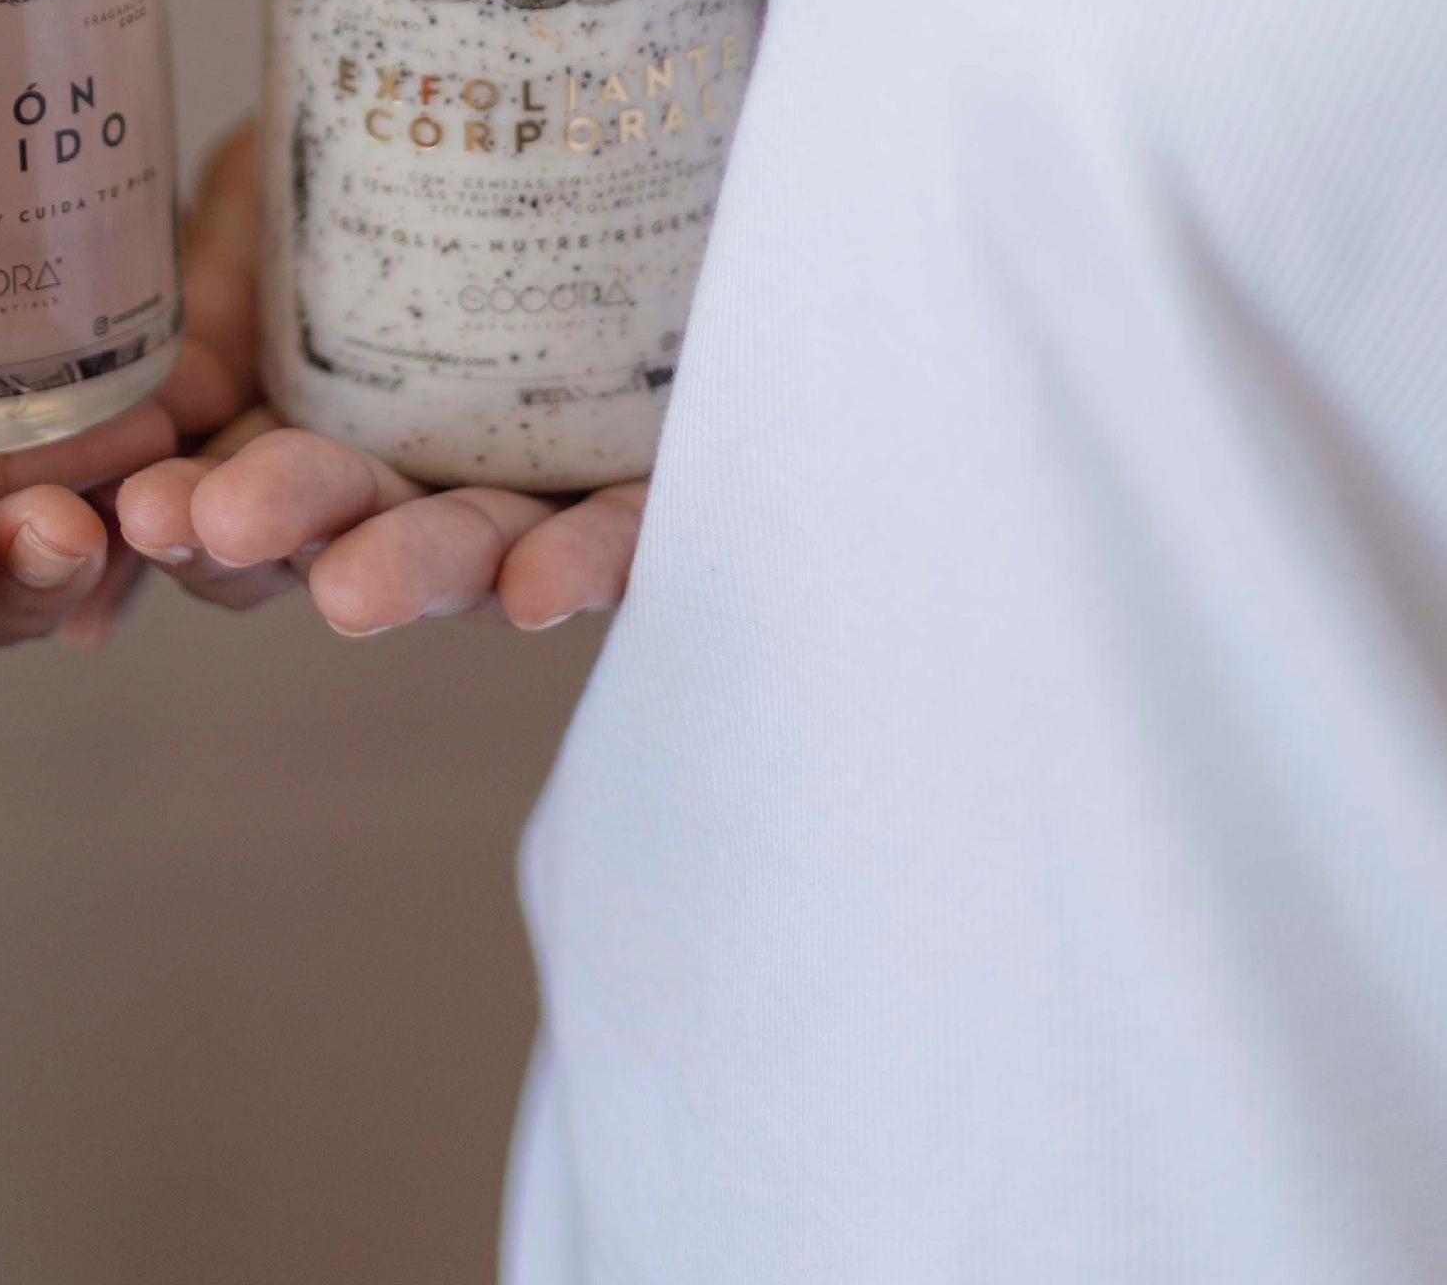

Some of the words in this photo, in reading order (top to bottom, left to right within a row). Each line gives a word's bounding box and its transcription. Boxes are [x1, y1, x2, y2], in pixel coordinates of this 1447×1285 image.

[338, 32, 738, 112] EXFOLIANTE
[364, 83, 721, 154] CORPORAL
[19, 198, 87, 223] CUIDA
[97, 185, 119, 202] TU
[429, 204, 524, 218] VITAMIA
[490, 234, 590, 254] NUTRE
[614, 202, 713, 243] REGENE
